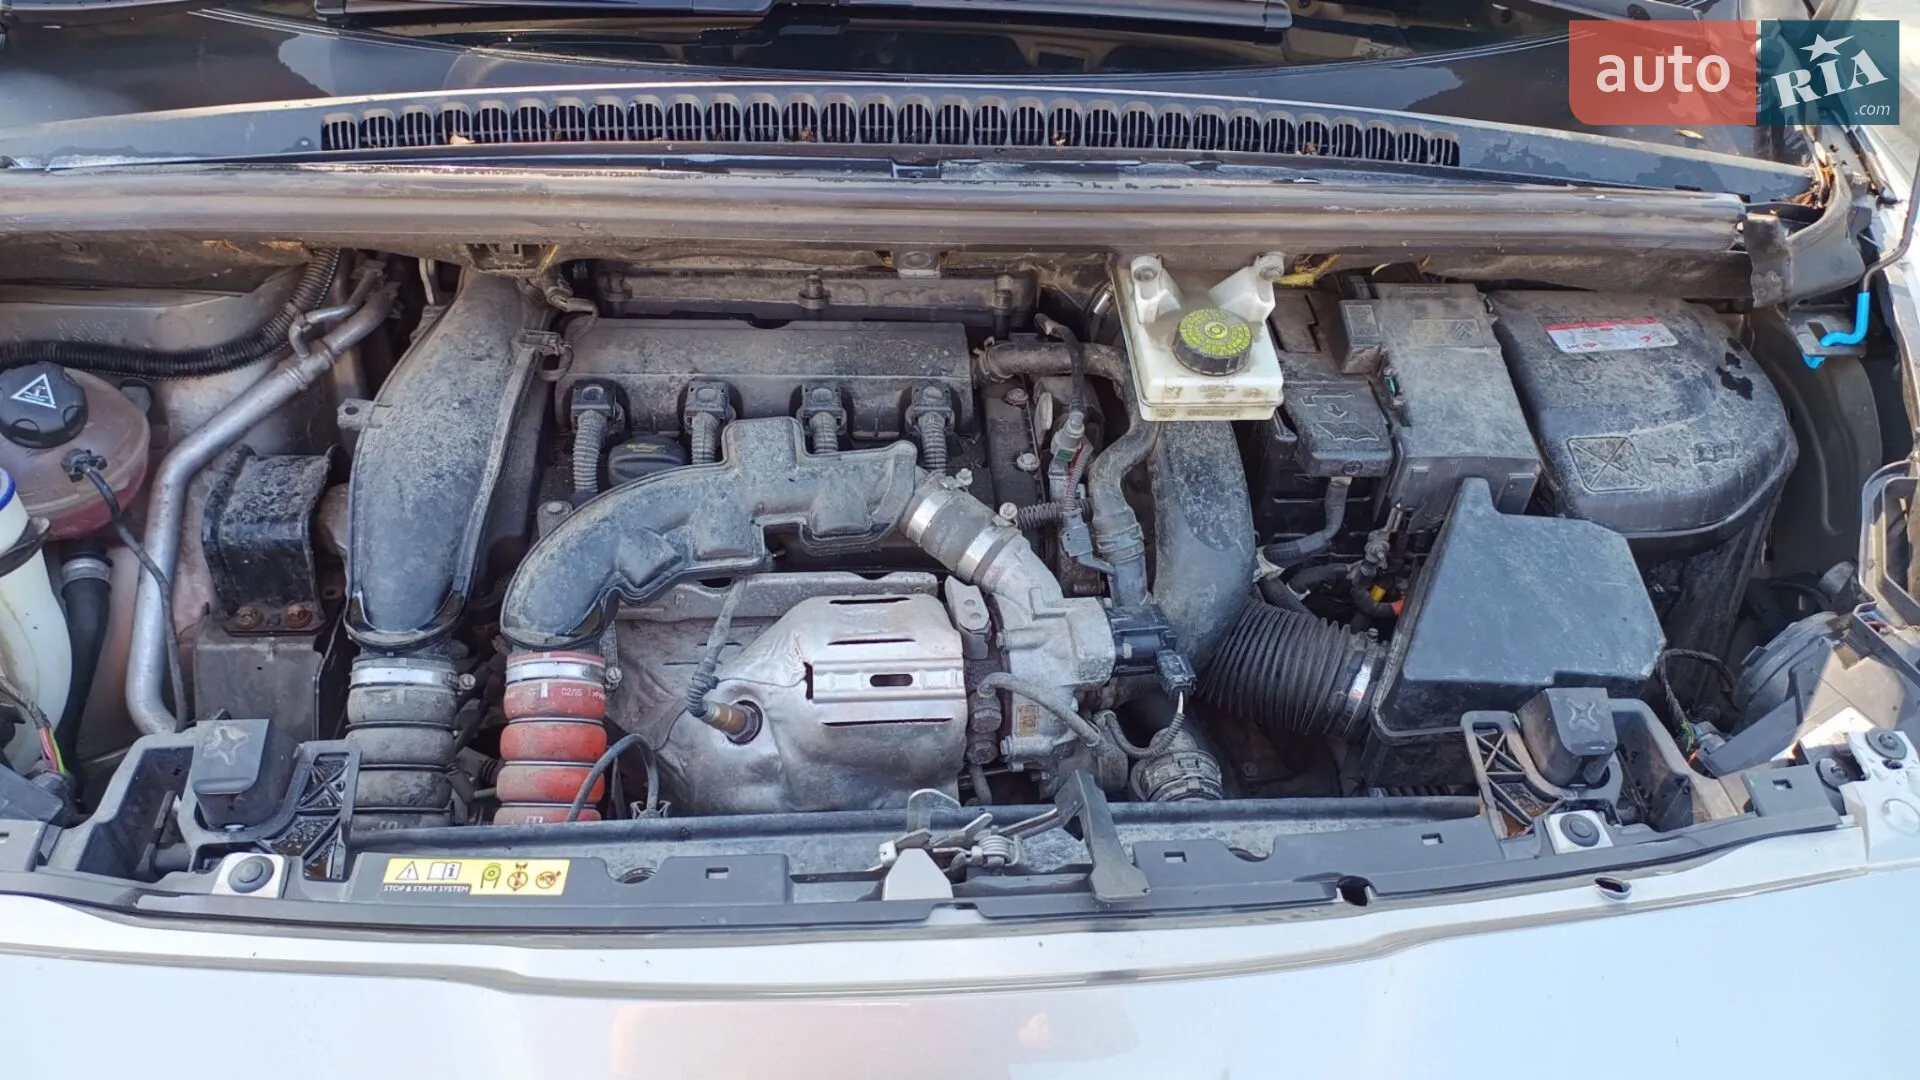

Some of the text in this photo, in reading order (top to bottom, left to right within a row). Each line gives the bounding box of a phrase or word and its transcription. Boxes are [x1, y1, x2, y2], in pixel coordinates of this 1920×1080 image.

[384, 884, 405, 892] STOP
[413, 884, 438, 892] START
[440, 884, 469, 892] SYSTEM
